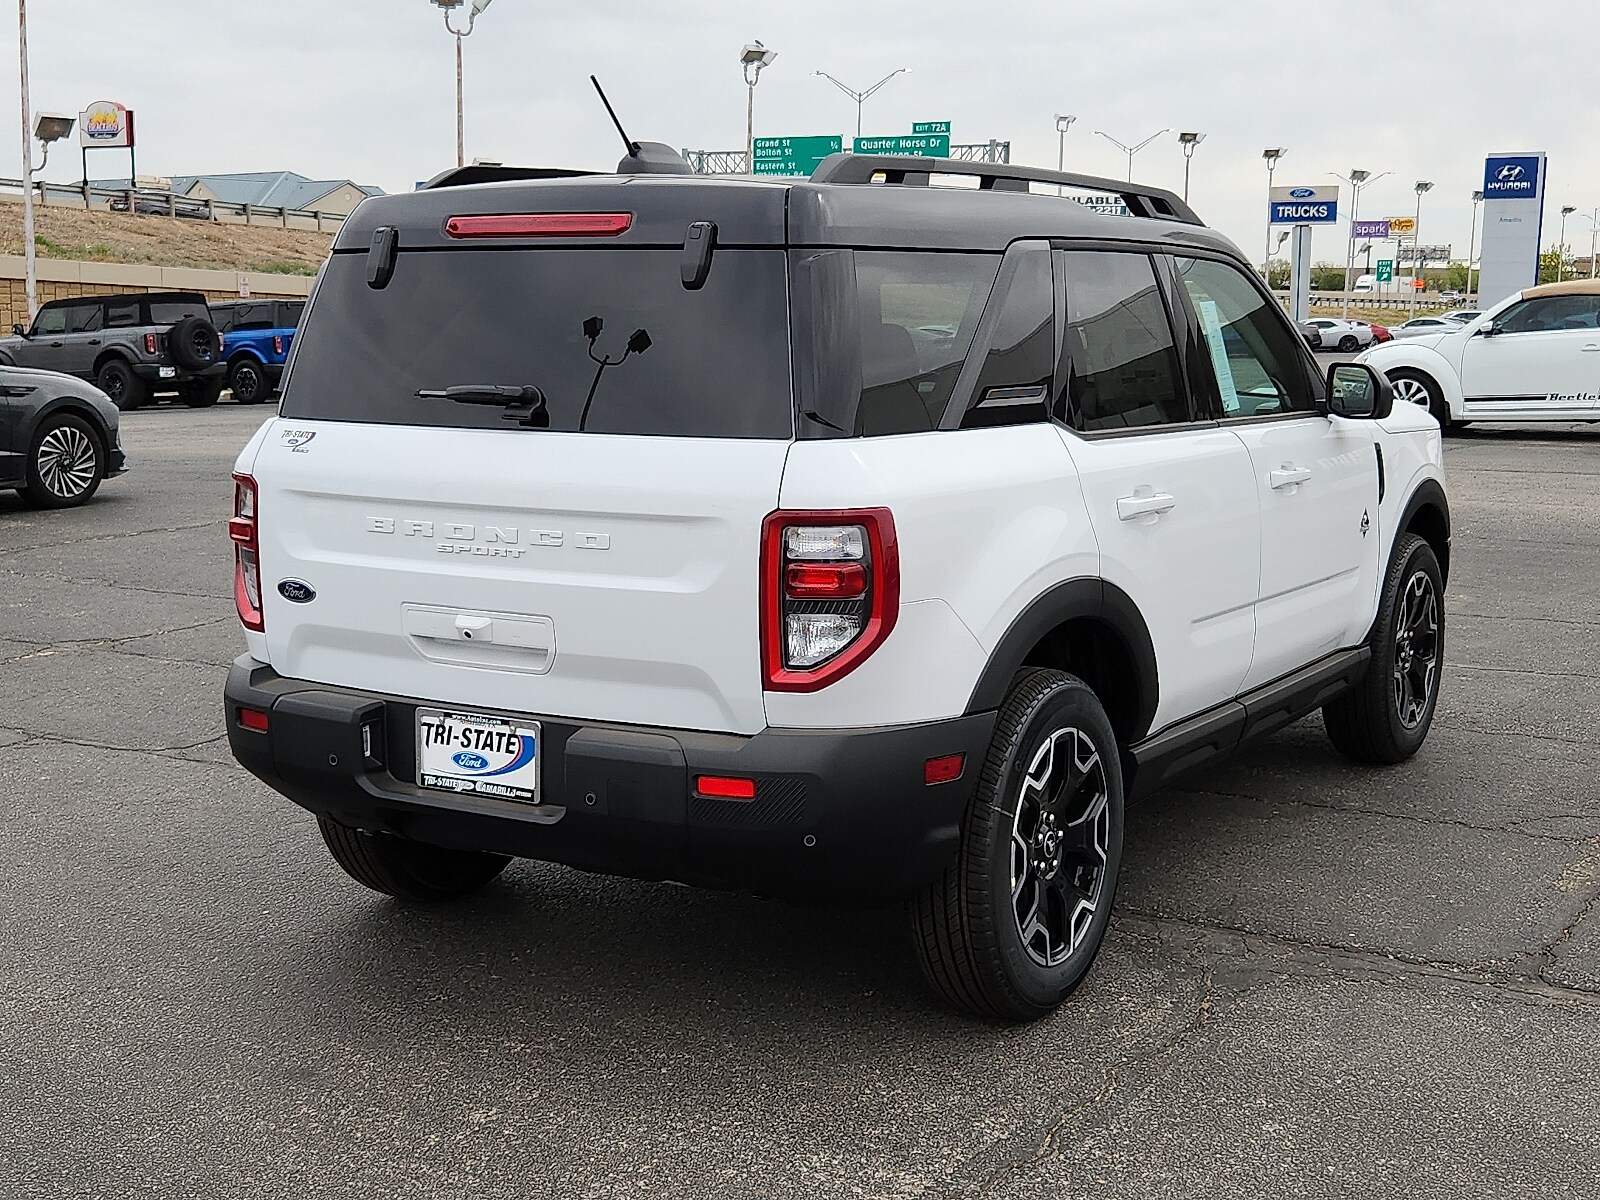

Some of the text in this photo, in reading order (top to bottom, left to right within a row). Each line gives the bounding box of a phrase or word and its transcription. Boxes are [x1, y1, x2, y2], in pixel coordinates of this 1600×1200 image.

[931, 123, 946, 132] 72A
[756, 140, 779, 148] Grand
[860, 138, 941, 150] Quarter Horse Dr
[756, 148, 793, 157] Bolton St
[756, 162, 796, 170] Eastern St
[1487, 181, 1531, 191] HYUNDAI
[1276, 205, 1328, 218] TRUCKS
[1356, 222, 1386, 236] spark
[1549, 392, 1596, 401] Beetle
[366, 516, 611, 551] BRONCO
[436, 543, 527, 558] SPORT
[283, 582, 306, 599] Ford
[420, 721, 519, 755] TRI-STATE
[458, 754, 483, 769] Ford
[423, 775, 459, 790] TRI-STATE
